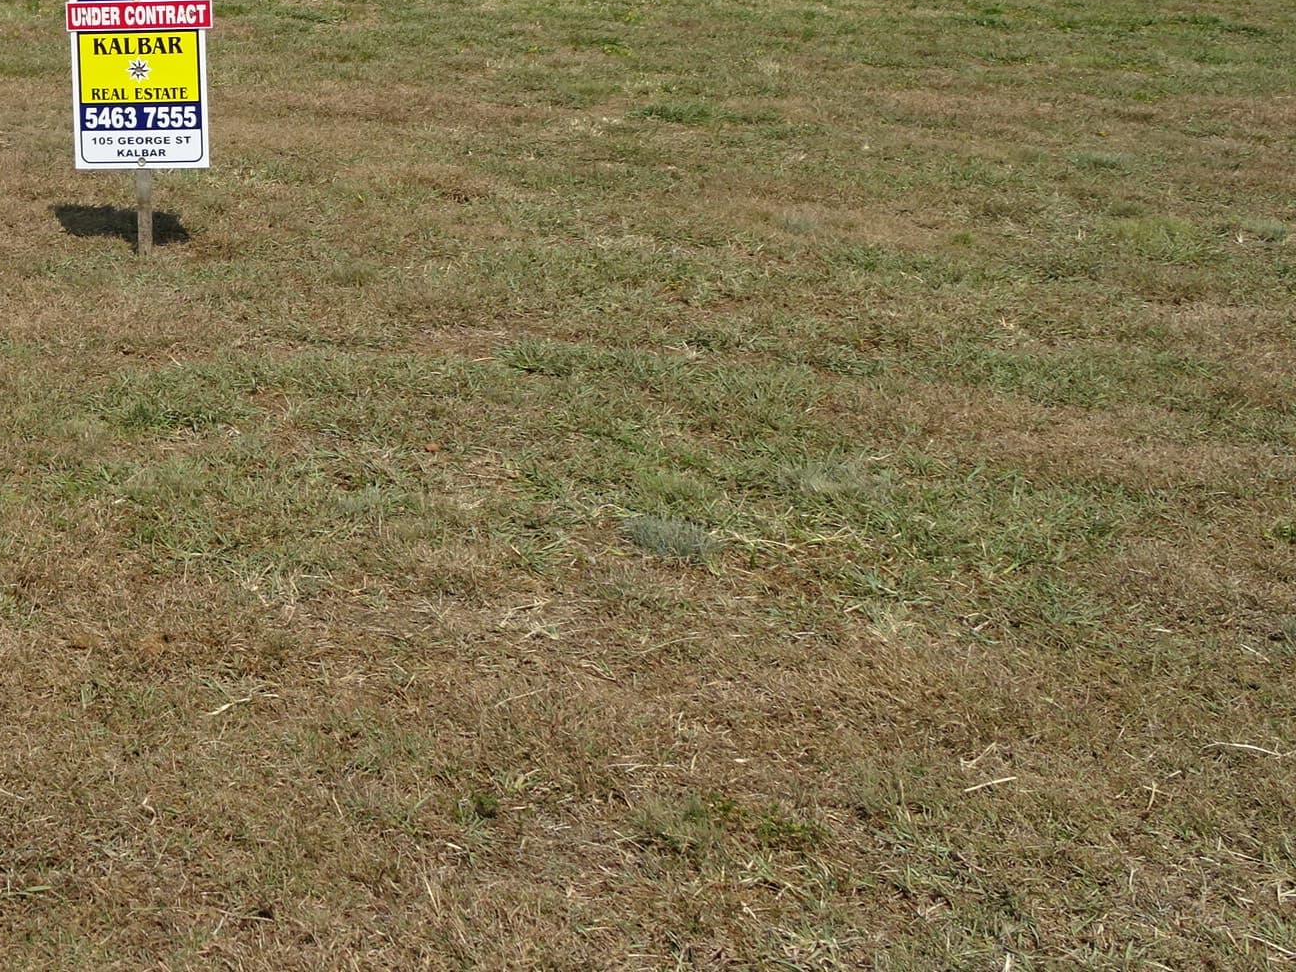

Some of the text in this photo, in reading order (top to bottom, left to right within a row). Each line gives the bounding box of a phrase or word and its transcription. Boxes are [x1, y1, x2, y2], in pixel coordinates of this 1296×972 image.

[71, 4, 206, 26] UNDER CONTRACT
[93, 37, 183, 55] KALBAR
[91, 87, 188, 100] REAL ESTATE
[85, 106, 197, 129] 5463 7555
[91, 136, 191, 145] 105 GEORGE ST
[117, 149, 166, 157] KALBAR
